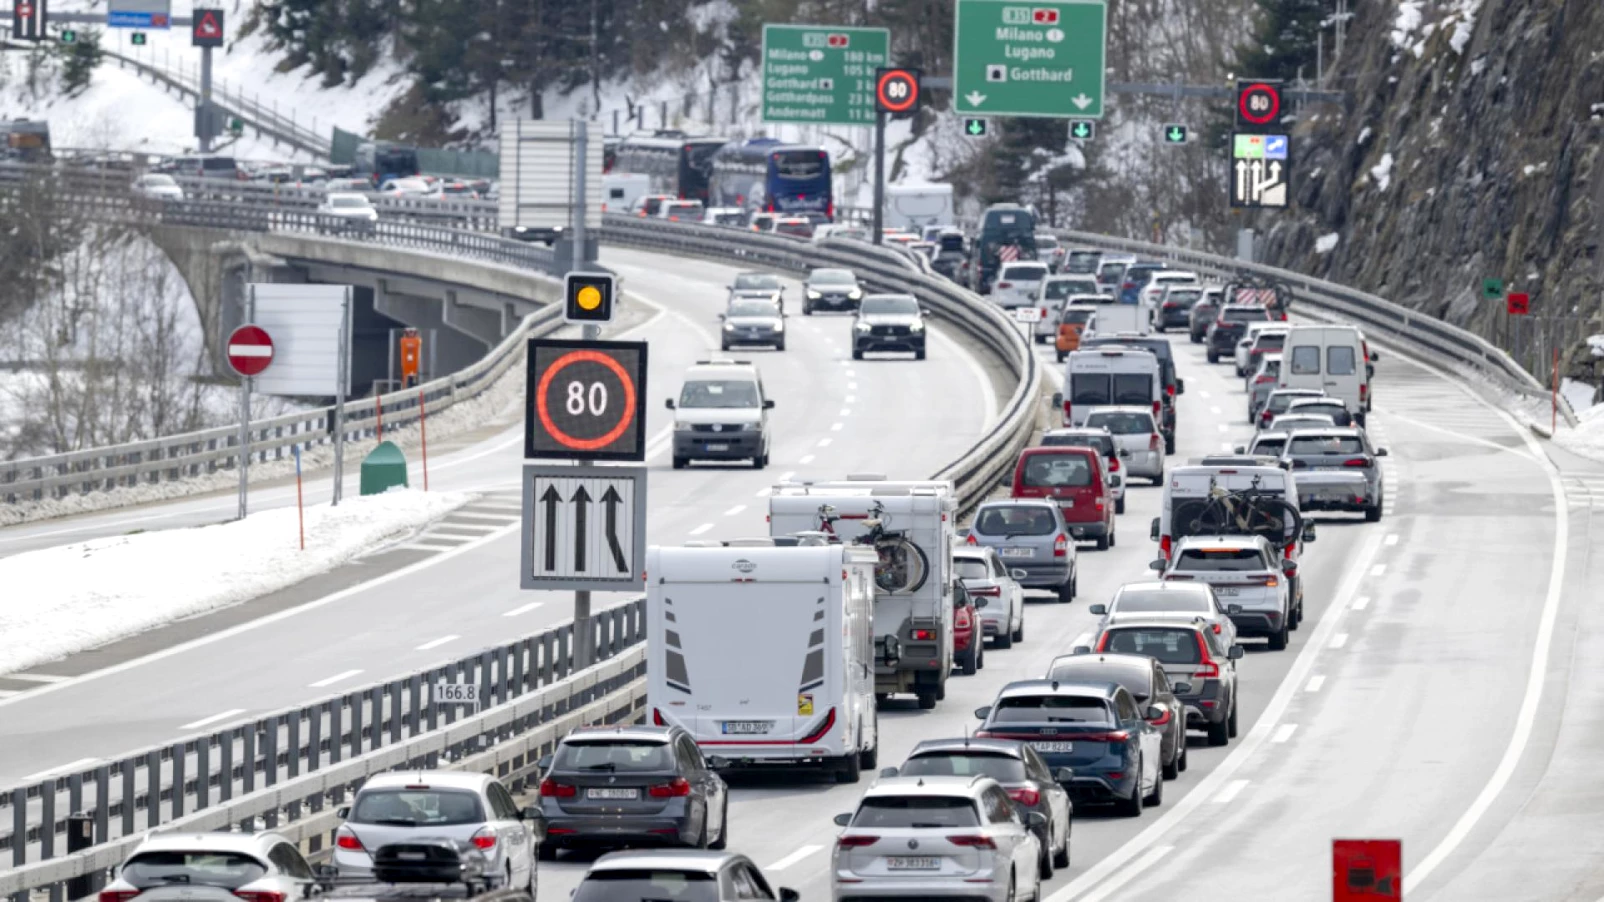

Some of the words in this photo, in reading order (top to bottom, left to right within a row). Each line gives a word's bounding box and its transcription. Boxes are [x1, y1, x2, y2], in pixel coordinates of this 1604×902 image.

[996, 28, 1043, 41] Milano
[768, 49, 807, 60] Milano
[844, 52, 863, 62] 180
[866, 52, 884, 62] km
[1005, 45, 1055, 61] Lugano
[767, 63, 808, 75] Lugano
[843, 65, 862, 76] 105
[1010, 68, 1072, 81] Gotthard
[767, 77, 817, 89] Gotthard
[856, 80, 862, 90] 3
[888, 82, 906, 98] 80
[767, 91, 834, 105] Gotthardpass
[848, 93, 862, 105] 23
[865, 94, 875, 105] k
[1250, 95, 1269, 110] 80
[767, 106, 826, 118] Andermatt
[849, 109, 861, 119] 11
[566, 380, 608, 416] 80
[438, 685, 475, 700] 166.8
